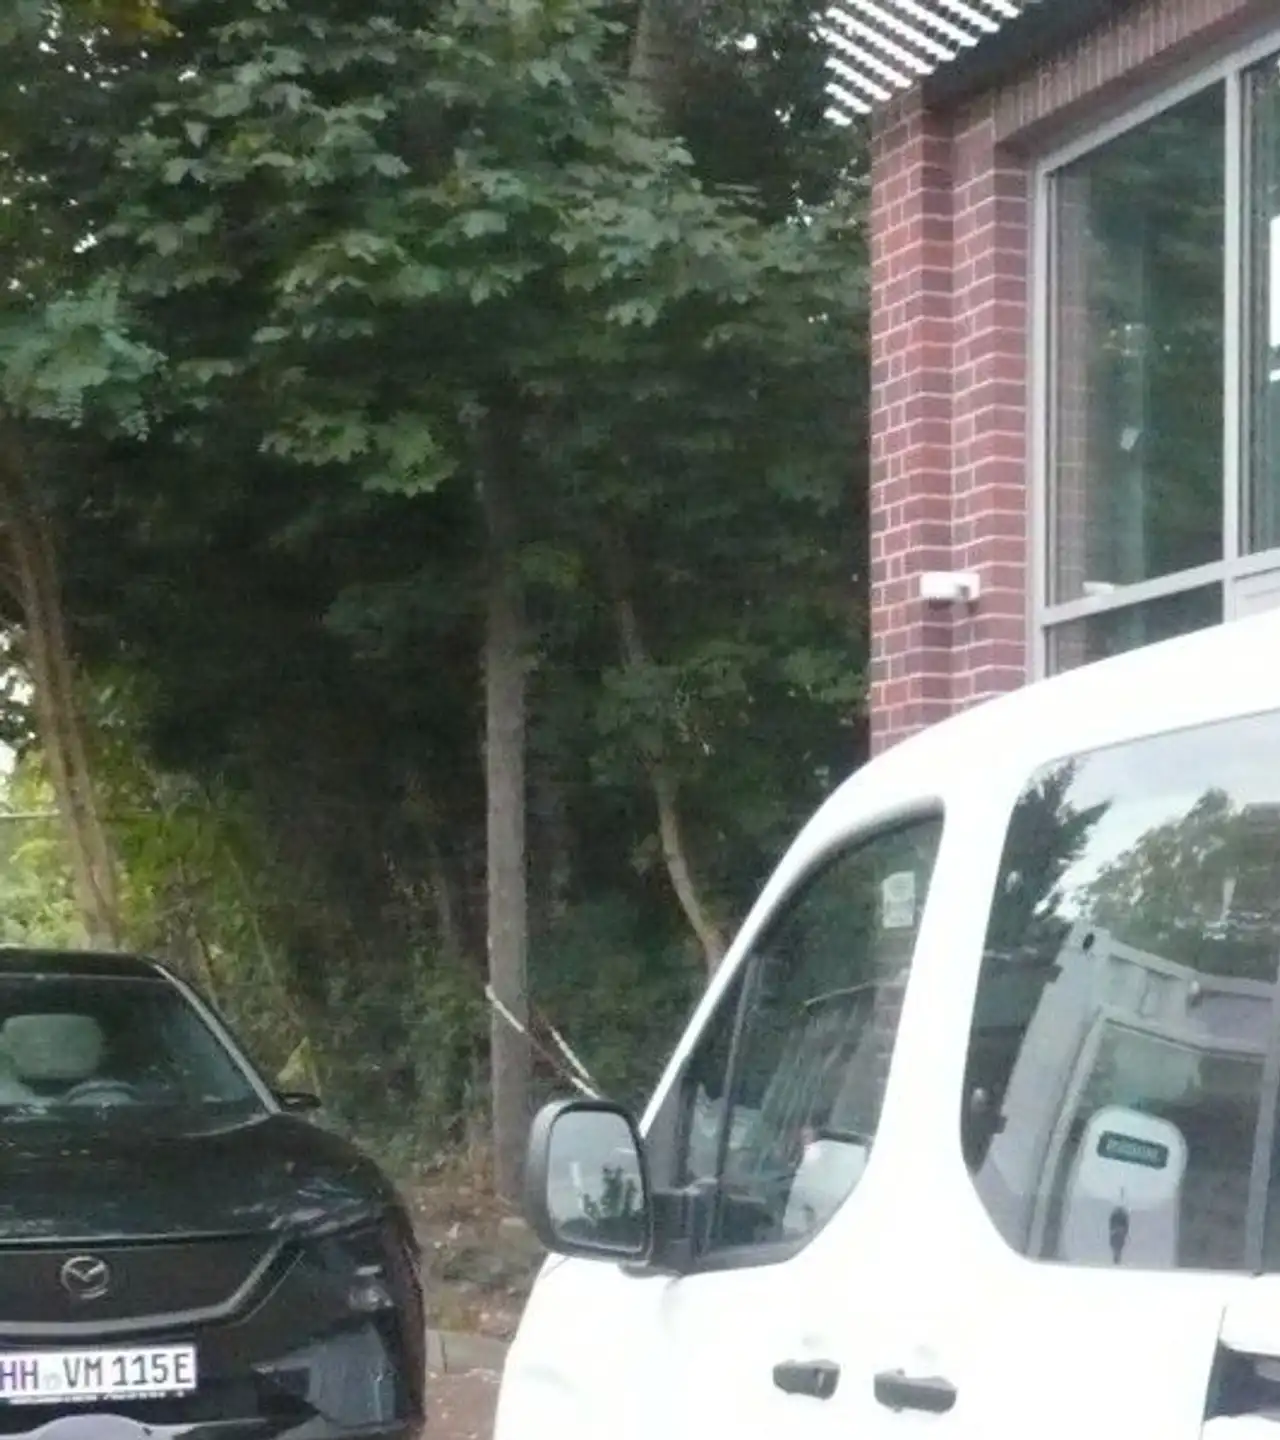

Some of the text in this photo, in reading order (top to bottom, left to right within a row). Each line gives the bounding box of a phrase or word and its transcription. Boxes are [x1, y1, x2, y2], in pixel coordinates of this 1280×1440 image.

[0, 1352, 192, 1390] HH VM 115E
